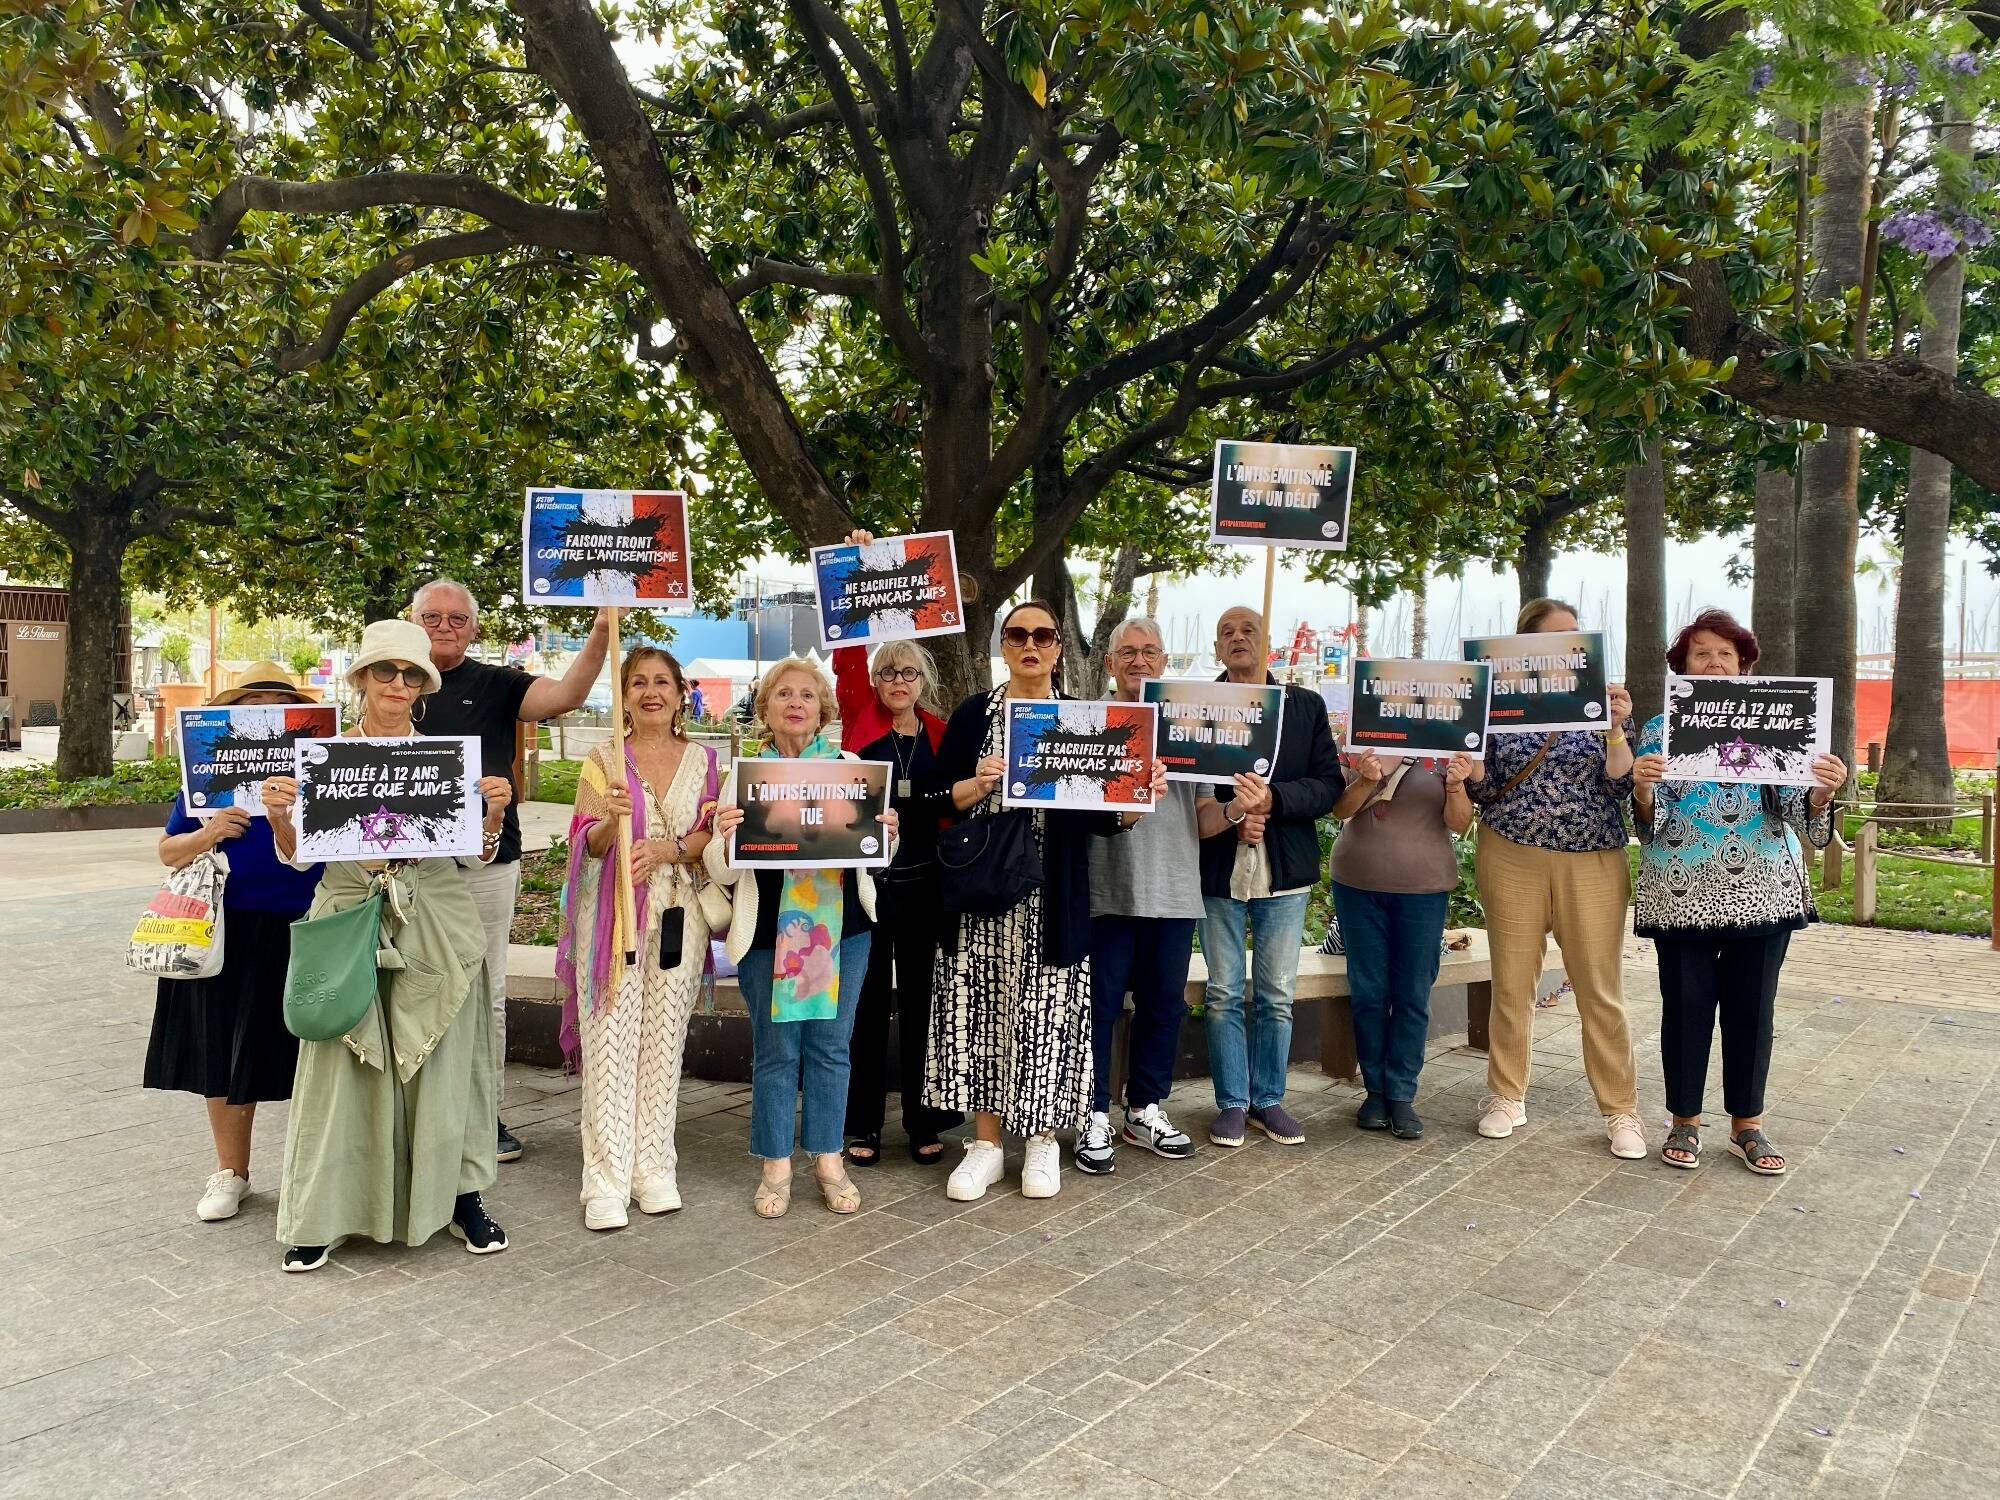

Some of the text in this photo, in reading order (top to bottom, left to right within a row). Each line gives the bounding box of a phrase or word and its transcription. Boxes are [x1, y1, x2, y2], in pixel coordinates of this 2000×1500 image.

[1241, 488, 1320, 509] EST UN DÉLIT
[566, 534, 653, 549] FAISONS FRONT
[538, 548, 584, 562] CONTRE
[846, 574, 930, 594] NE SACRIFIEZ PAS
[830, 586, 946, 611] LES FRANÇAIS JUIFS
[1326, 647, 1333, 656] P
[1494, 674, 1577, 696] EST UN DÉLIT
[1160, 701, 1263, 724] 'ANTISÉMITISME
[1380, 702, 1462, 721] EST UN DÉLIT
[1694, 698, 1794, 716] VIOLÉE À 12 ANS
[1680, 714, 1805, 731] PARCE QUE JUIVE
[1168, 725, 1251, 746] EST UN DÉLIT
[216, 748, 264, 762] FAISONS
[266, 747, 295, 760] FRON
[1036, 742, 1127, 756] NE SACRIFIEZ PAS
[192, 763, 234, 776] CONTRE
[330, 764, 440, 783] VIOLÉE À 12 ANS
[1018, 756, 1144, 773] LES FRANÇAIS JUIFS
[316, 780, 452, 800] PARCE QUE JUIVE
[747, 779, 868, 801] L'ANTISÉMITISME
[800, 807, 824, 825] TUE
